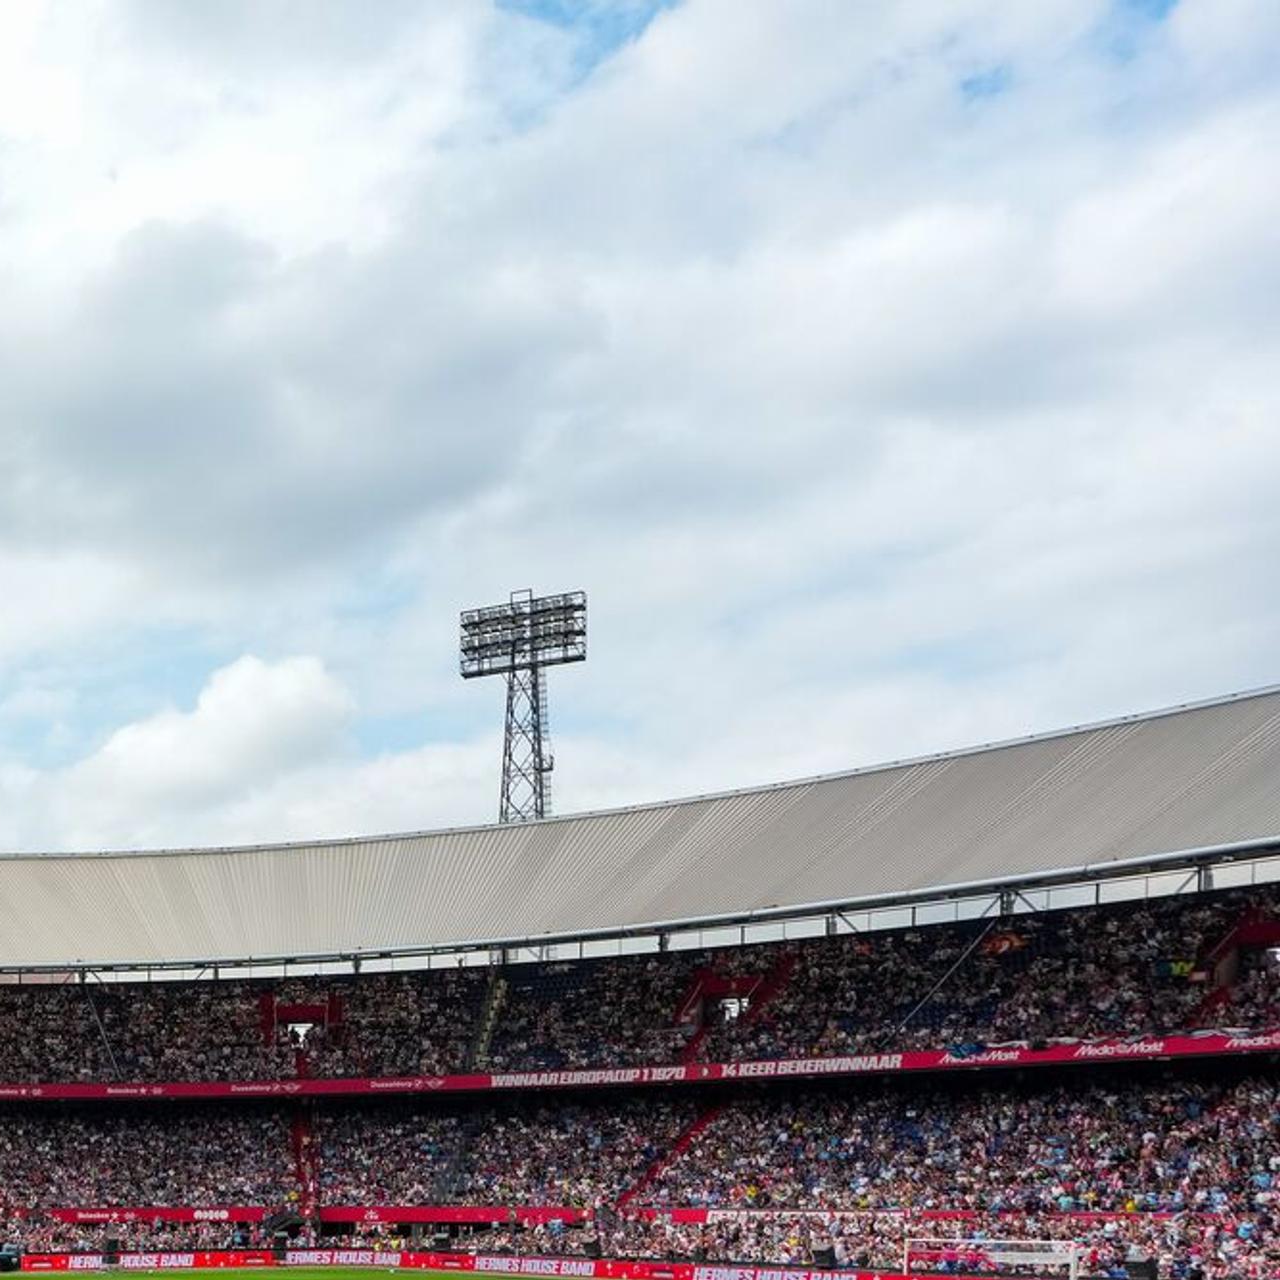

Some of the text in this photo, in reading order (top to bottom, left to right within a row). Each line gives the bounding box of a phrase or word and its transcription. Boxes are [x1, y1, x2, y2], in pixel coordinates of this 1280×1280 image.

[491, 1072, 559, 1088] WINNAAR
[650, 1066, 687, 1081] 1970
[738, 1061, 776, 1077] KEER
[777, 1055, 903, 1075] BEKERWINNAAR
[474, 1256, 520, 1273] HERMES
[520, 1258, 559, 1275] HOUSE
[560, 1261, 595, 1277] BAND
